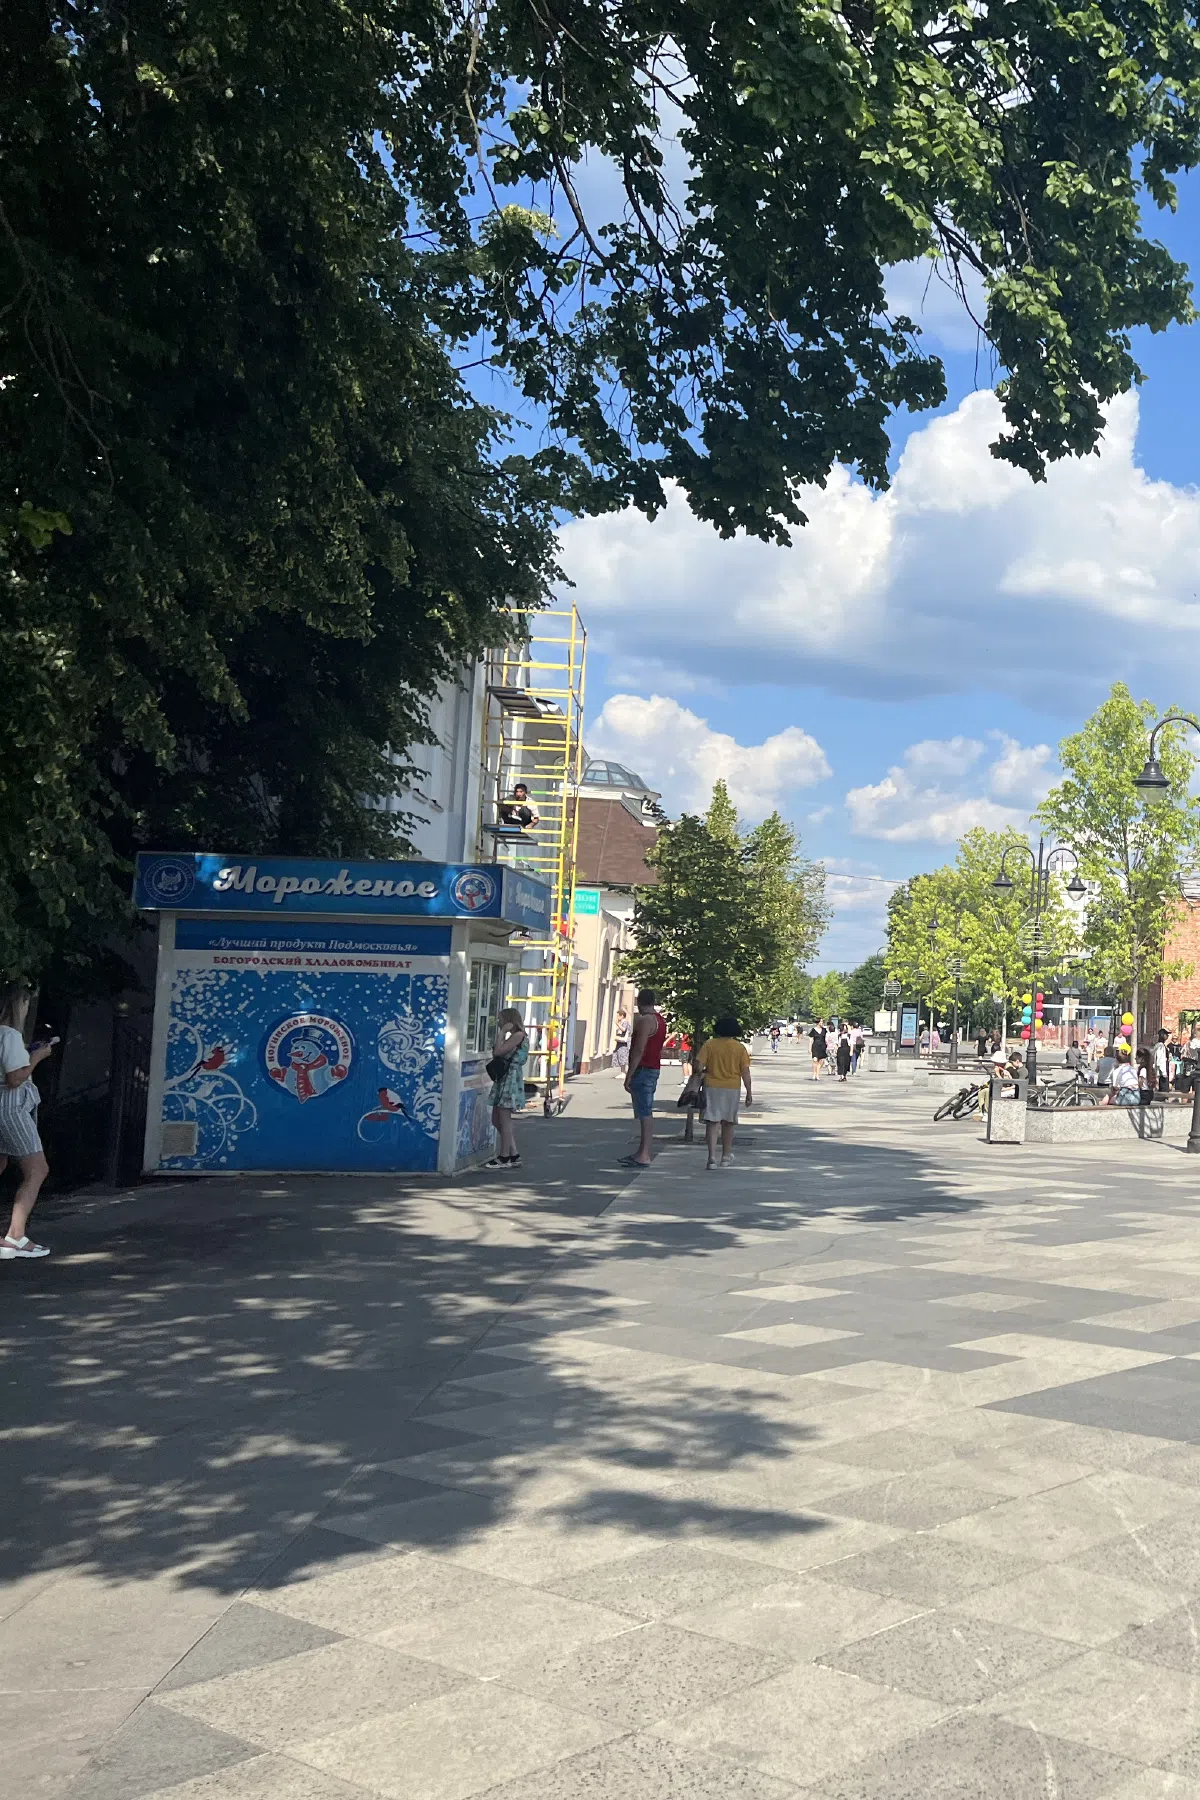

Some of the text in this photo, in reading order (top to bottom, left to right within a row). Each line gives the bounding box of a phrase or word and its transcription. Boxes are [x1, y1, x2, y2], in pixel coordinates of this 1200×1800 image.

[212, 865, 439, 904] Мороженое
[269, 939, 327, 950] продукт
[213, 955, 413, 969] БОГОРОДСКИЙ ХЛАДОКОМБИНАТ
[267, 1016, 350, 1062] НОГИНСКОЕ МОРОЖЕНОЕ
